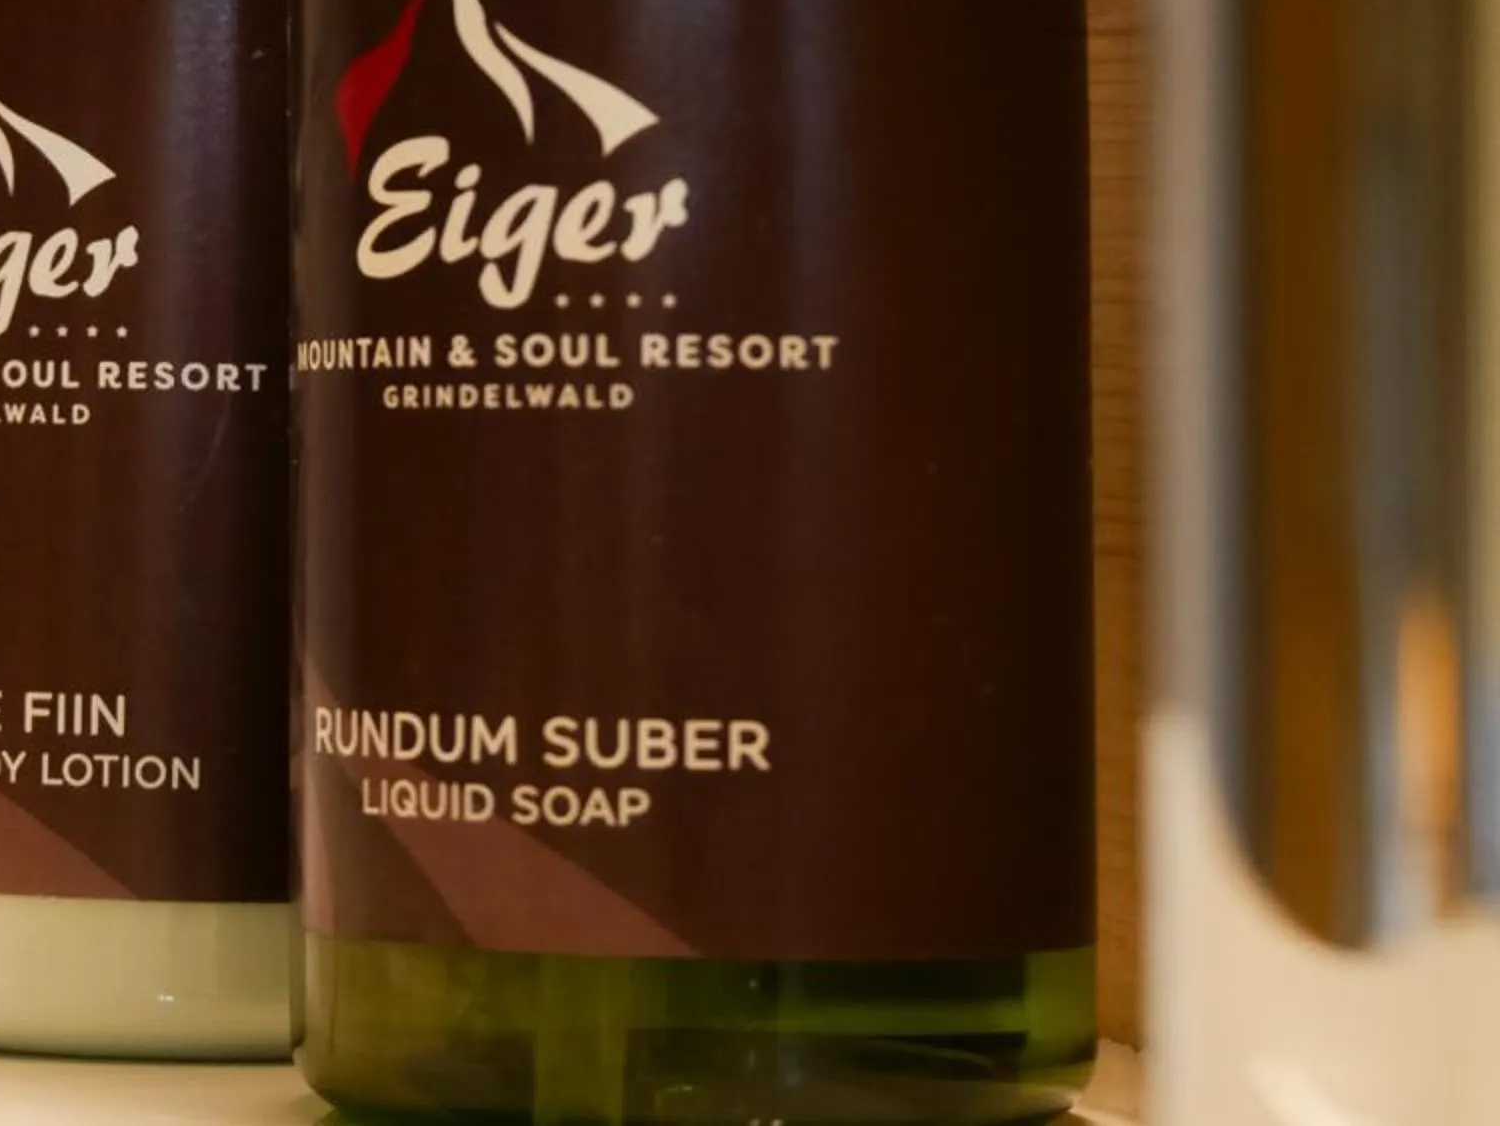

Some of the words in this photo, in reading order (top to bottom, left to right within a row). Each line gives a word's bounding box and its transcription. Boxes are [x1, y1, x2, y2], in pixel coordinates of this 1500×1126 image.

[357, 135, 688, 309] Eiger
[447, 336, 476, 368] &
[494, 334, 620, 369] SOUL
[640, 335, 840, 370] RESORT
[98, 362, 268, 391] RESORT
[383, 383, 634, 410] GRINDELWALD
[23, 691, 126, 738] FIIN
[315, 706, 519, 766] RUNDUM
[542, 716, 772, 771] SUBER
[41, 751, 201, 791] LOTION
[361, 778, 495, 823] LIQUID
[510, 785, 652, 828] SOAP
